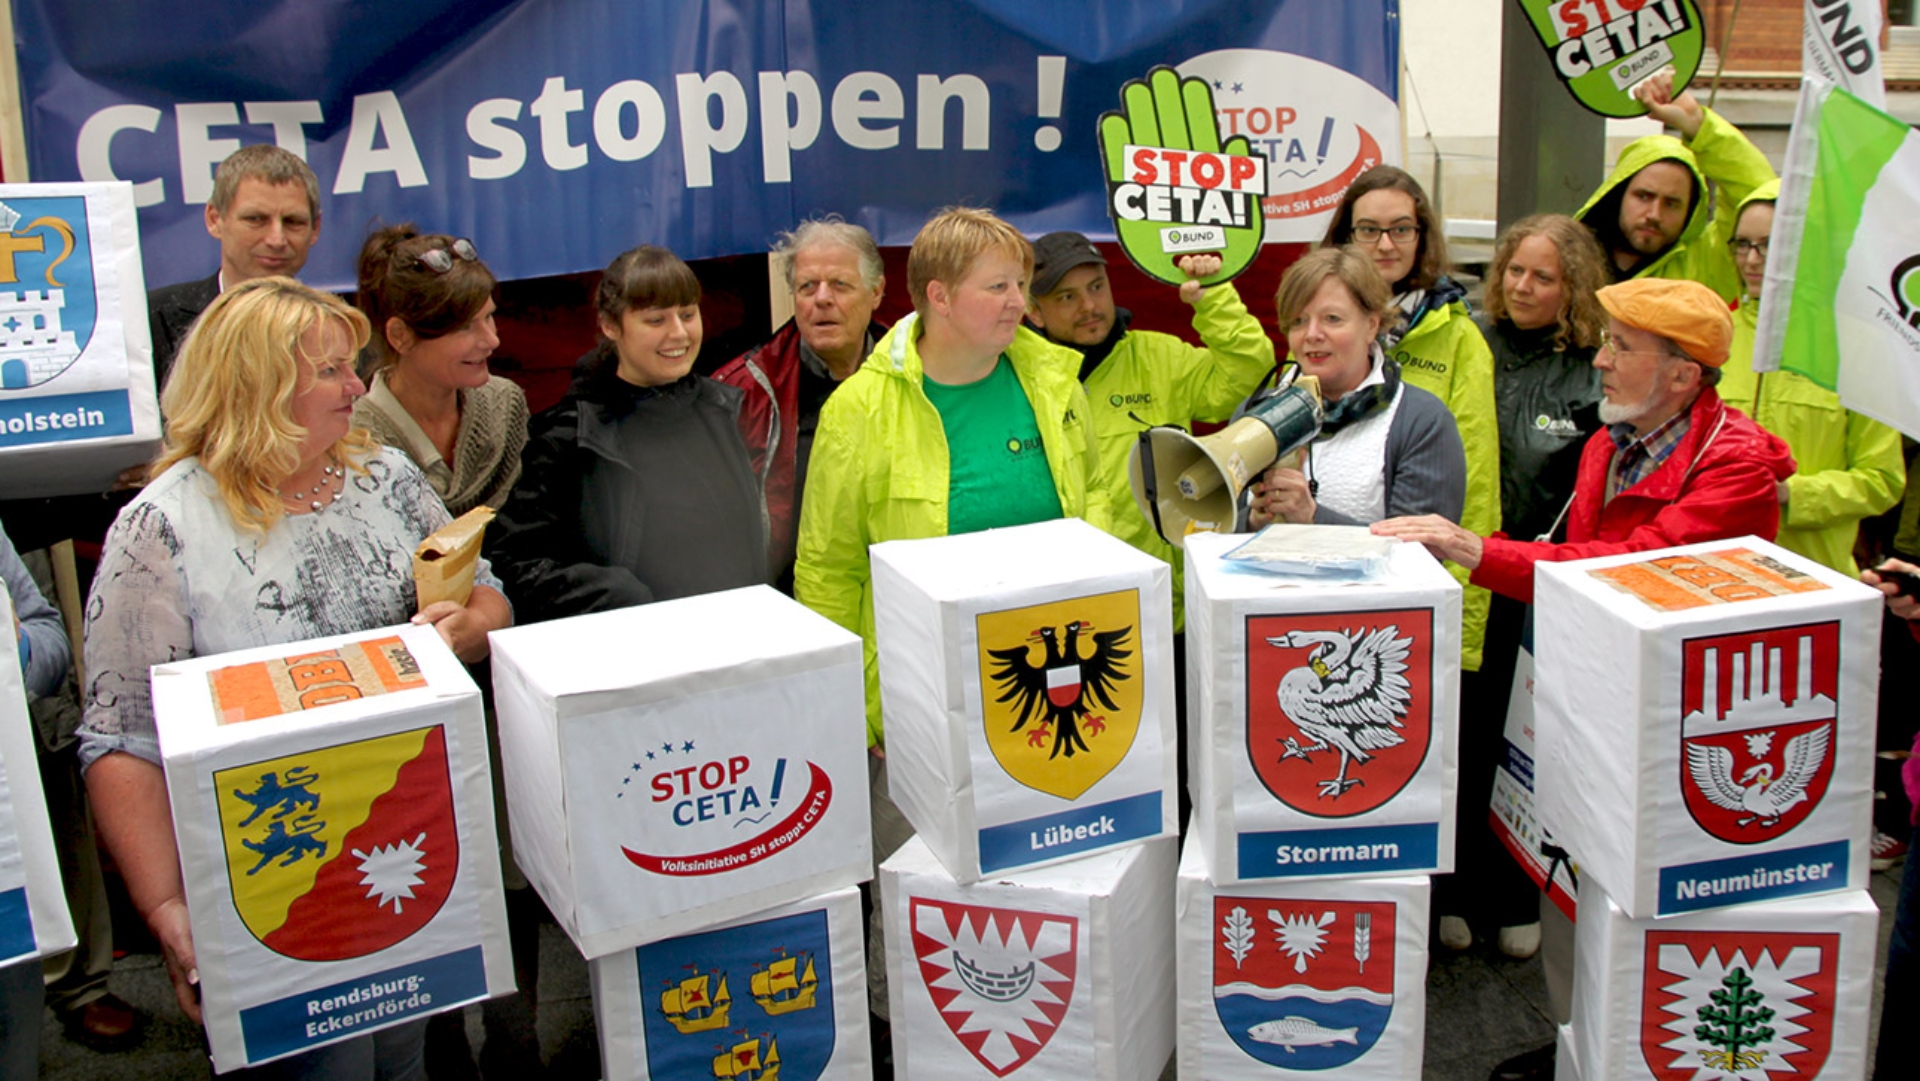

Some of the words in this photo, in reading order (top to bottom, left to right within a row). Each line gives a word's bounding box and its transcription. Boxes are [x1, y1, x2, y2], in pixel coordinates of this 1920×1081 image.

[1556, 0, 1685, 78] CETA!
[1631, 50, 1660, 73] BUND
[76, 90, 429, 208] CETA
[465, 69, 990, 188] stoppen
[1034, 55, 1067, 153] !
[1216, 107, 1297, 135] TOP
[1132, 149, 1256, 189] STOP
[1114, 183, 1246, 225] CETA!
[1293, 199, 1311, 212] SH
[1183, 231, 1214, 242] BUND
[1409, 358, 1447, 373] BUND
[651, 755, 750, 803] STOP
[661, 852, 748, 872] Volksinitiative
[749, 844, 767, 859] SH
[768, 822, 806, 850] stoppt
[803, 790, 826, 823] CETA
[1030, 815, 1116, 850] Lübeck
[1276, 842, 1399, 865] Stormarn
[1676, 862, 1834, 900] Neumünster
[305, 991, 432, 1038] Eckernförde
[307, 974, 425, 1016] Rendsburg-
